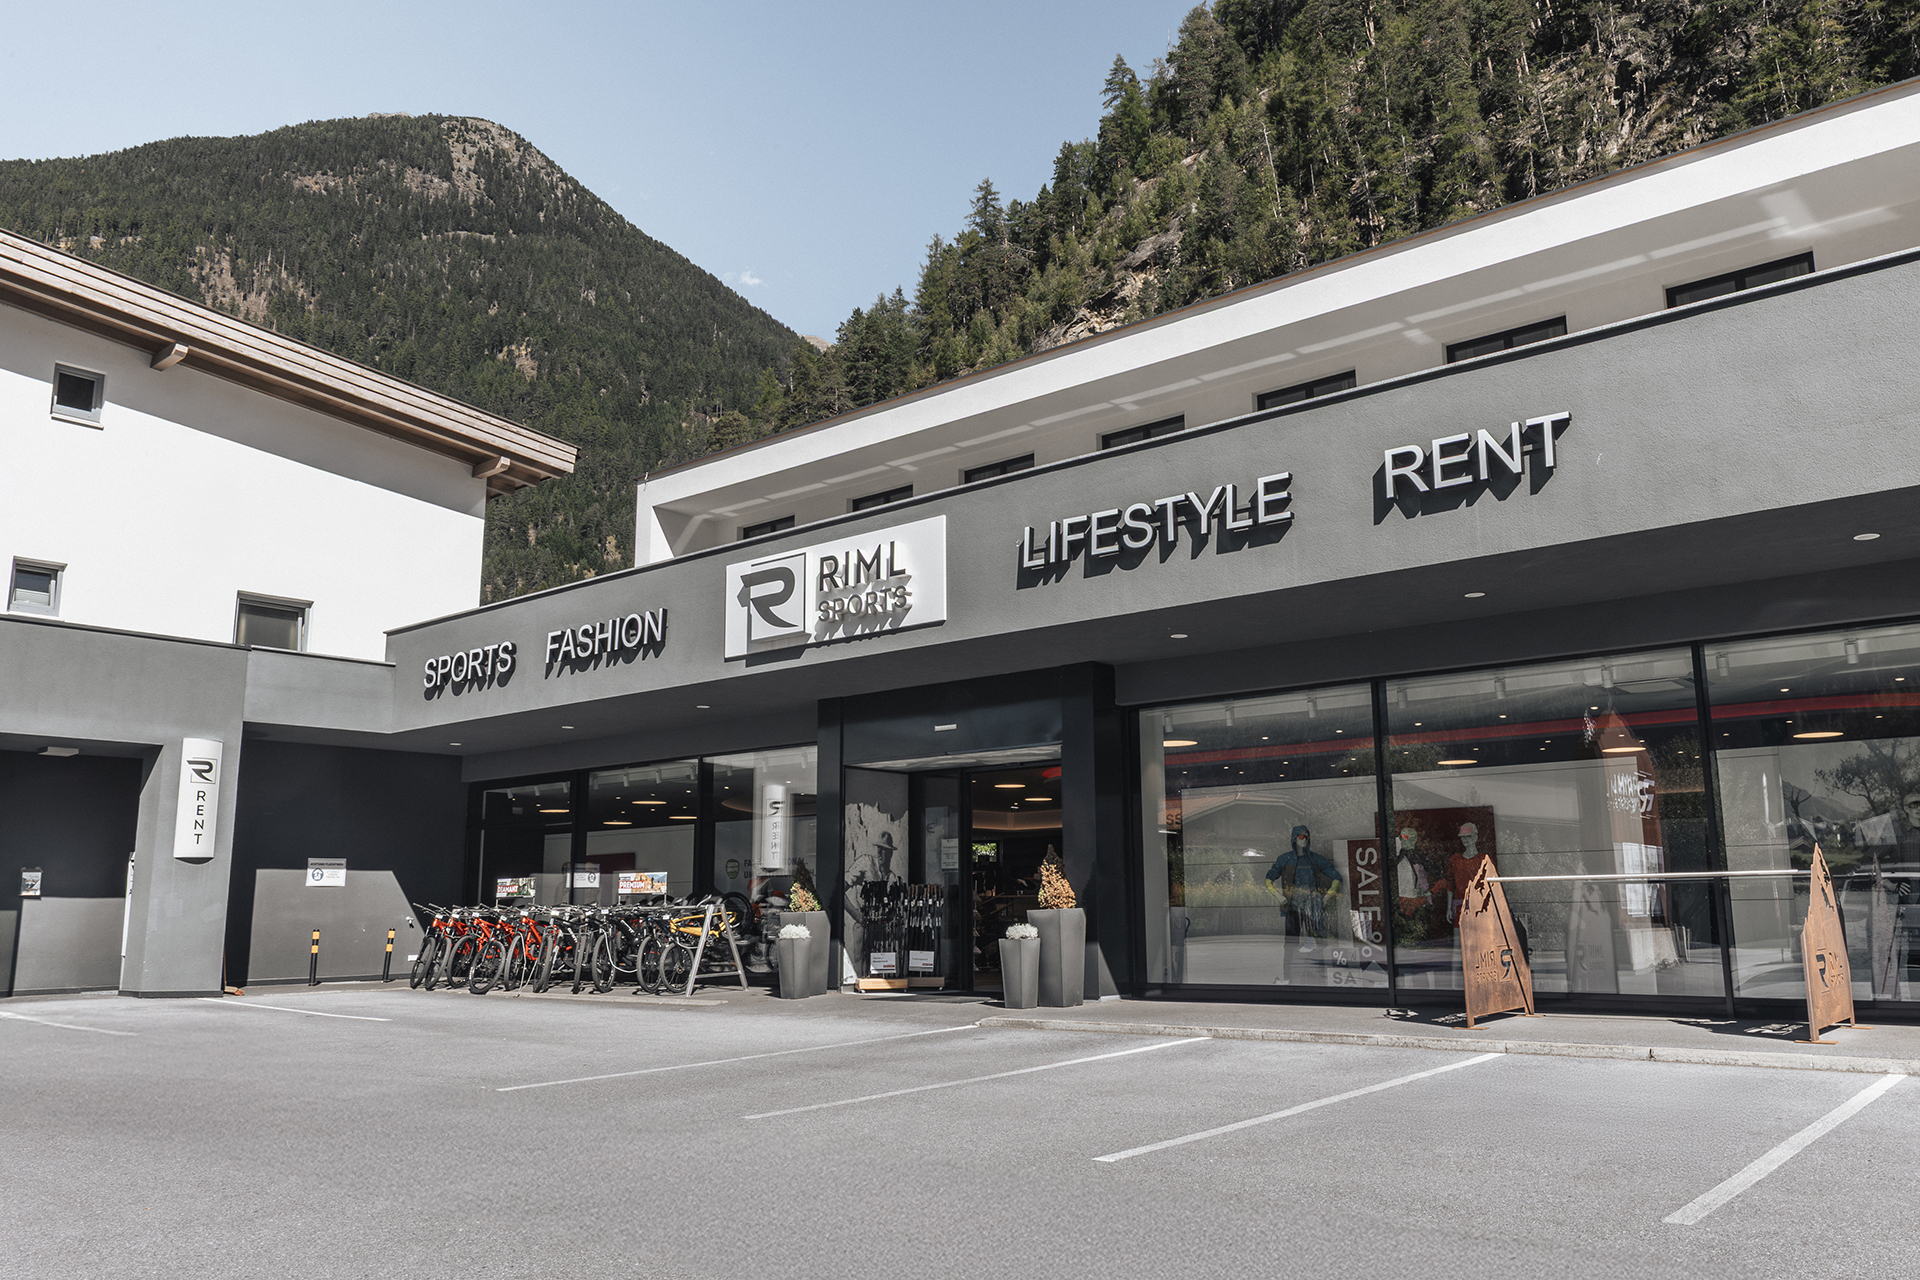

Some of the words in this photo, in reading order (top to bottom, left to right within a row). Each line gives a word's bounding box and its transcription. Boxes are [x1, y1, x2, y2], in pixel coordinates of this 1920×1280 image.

[1383, 411, 1572, 499] RENT
[1022, 471, 1293, 569] LIFESTYLE
[819, 540, 906, 592] RIML
[818, 585, 908, 623] SPORTS
[423, 641, 514, 689] SPORTS
[545, 607, 667, 664] FASHION
[194, 790, 206, 845] RENT
[619, 881, 645, 889] PREMIUM
[1355, 847, 1382, 922] SALE
